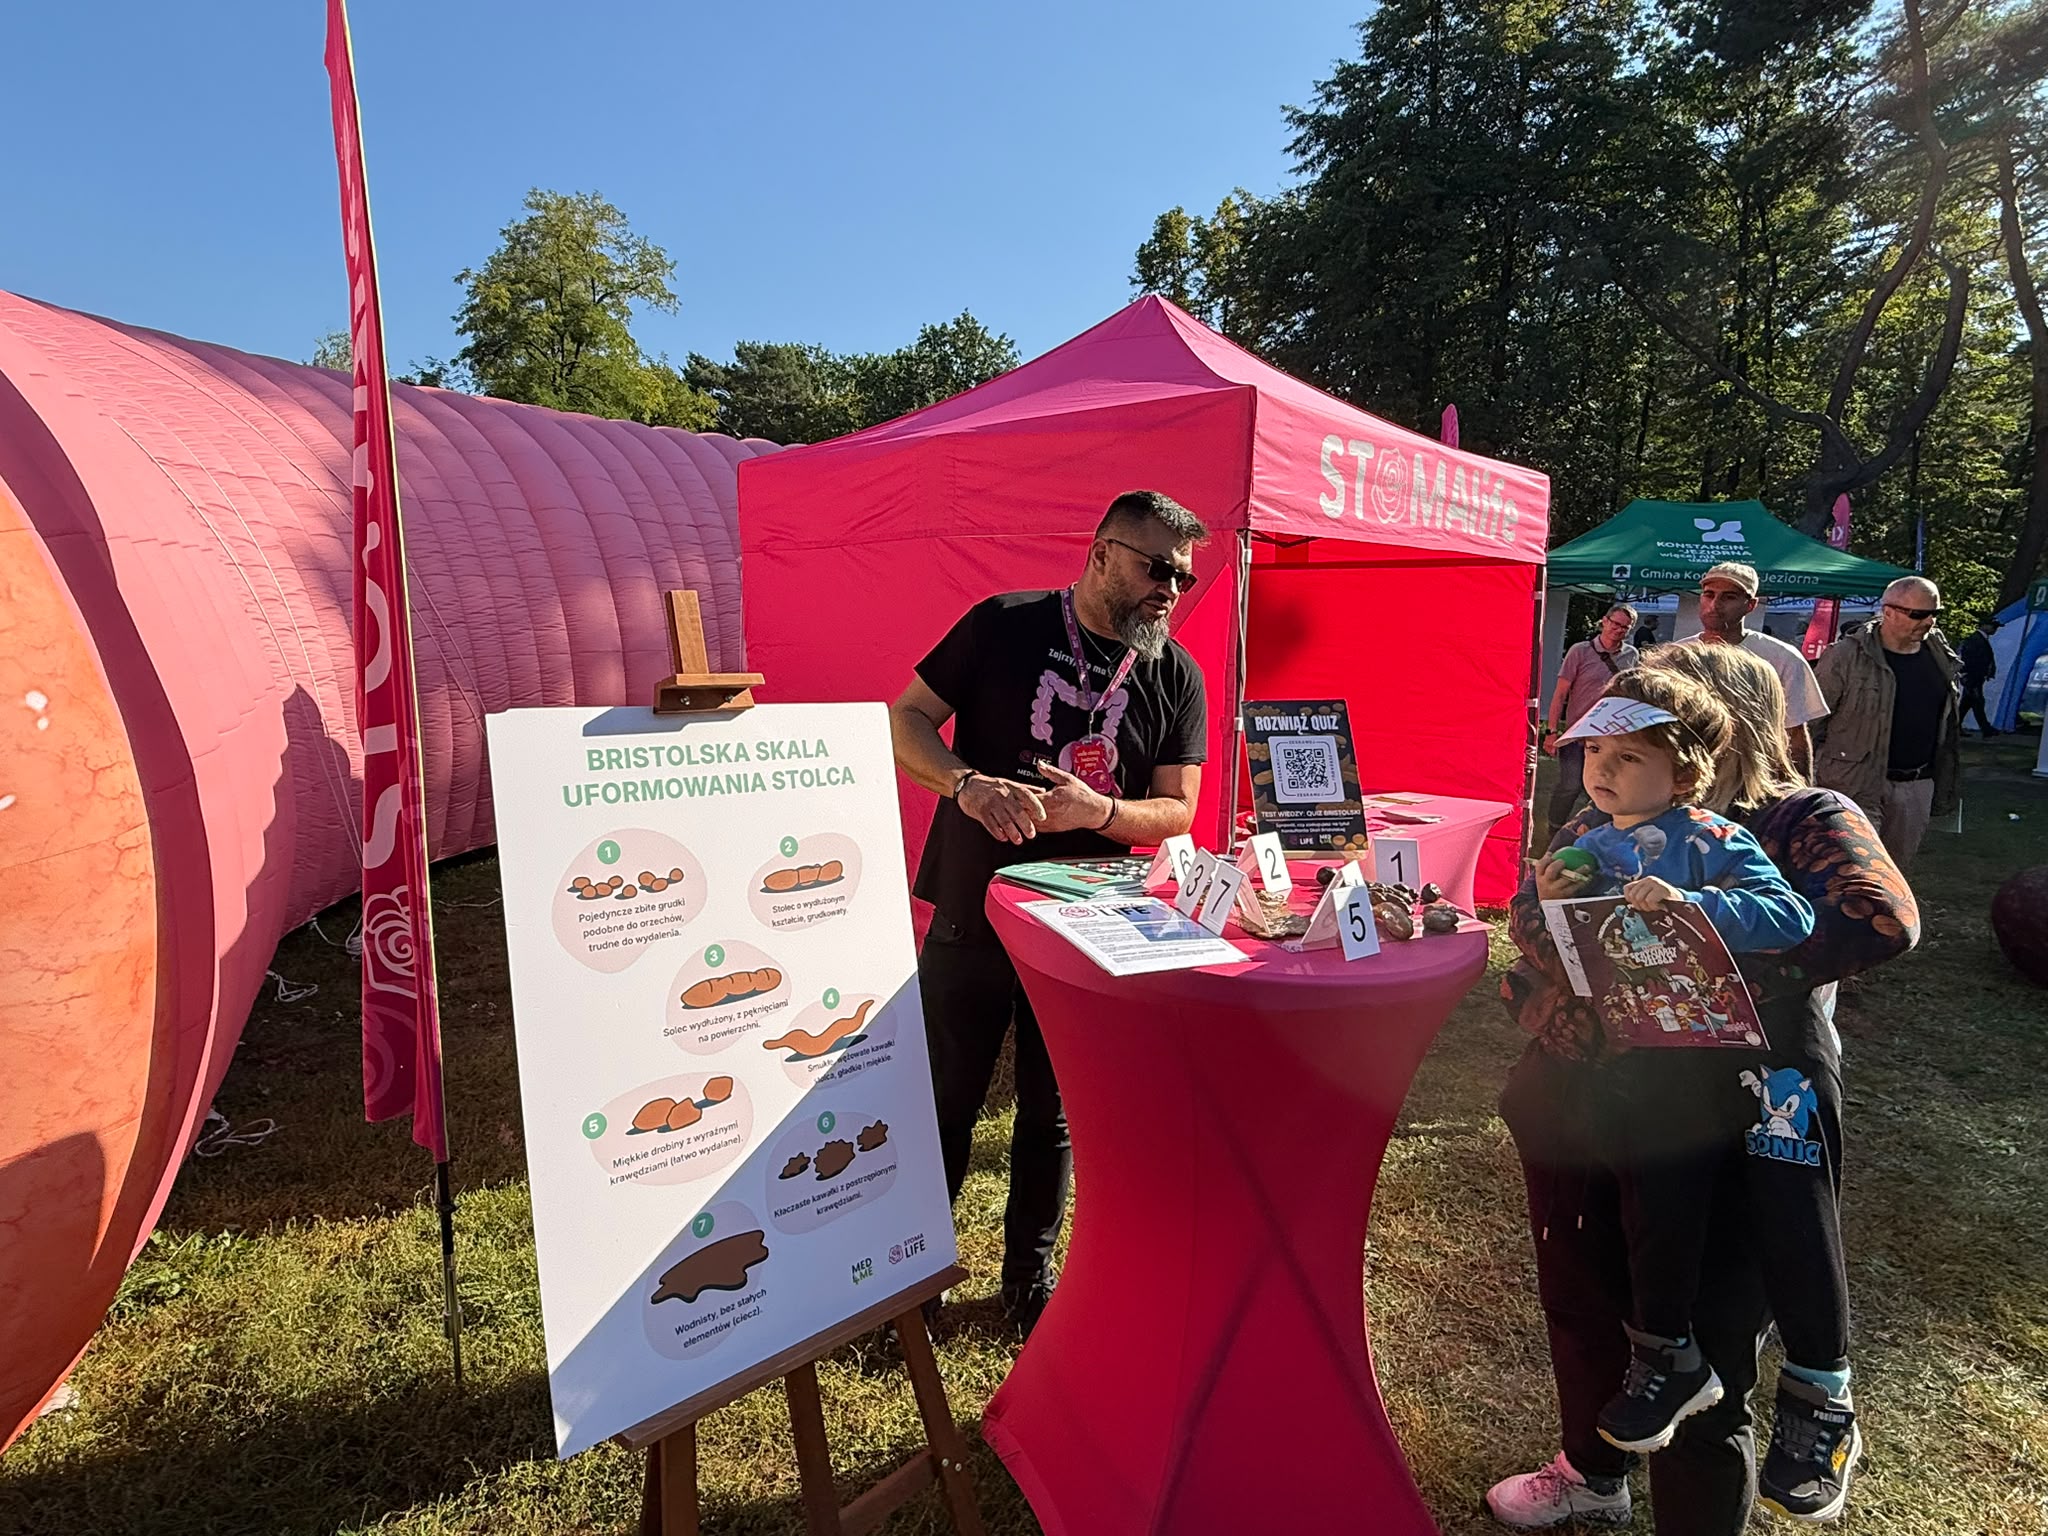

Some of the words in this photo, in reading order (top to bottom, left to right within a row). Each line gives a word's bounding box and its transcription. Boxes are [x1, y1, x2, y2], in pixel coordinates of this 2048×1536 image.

[1656, 541, 1750, 550] KONSTANCIN-
[1640, 568, 1680, 579] Gmina
[1254, 712, 1309, 735] ROZWIĄŻ
[1310, 715, 1339, 731] QUIZ
[586, 742, 751, 771] BRISTOLSKA
[755, 739, 830, 761] SKALA
[562, 772, 767, 808] UFORMOWANIA
[771, 766, 856, 791] STOLCA
[604, 846, 612, 858] 1
[784, 841, 792, 852] 2
[1264, 847, 1282, 880] 2
[1390, 851, 1403, 882] 1
[1186, 864, 1204, 897] 3
[1211, 879, 1231, 914] 7
[579, 907, 633, 923] Pojedyncze
[634, 903, 657, 914] zbite
[658, 898, 686, 912] grudki
[772, 903, 796, 914] Stolec
[1098, 906, 1151, 916] LIFE
[583, 923, 624, 939] podobne
[626, 921, 638, 930] do
[639, 914, 685, 928] orzechów,
[1349, 902, 1366, 943] 5
[588, 939, 620, 952] trudne
[621, 937, 634, 946] do
[635, 928, 681, 944] wydalenia.
[709, 949, 719, 962] 3
[827, 993, 834, 1004] 4
[663, 1025, 688, 1037] Solec
[689, 1013, 736, 1031] wydłużony,
[743, 999, 789, 1019] pęknięciami
[698, 1034, 709, 1043] na
[710, 1020, 761, 1042] powierzchni.
[588, 1119, 599, 1133] 5
[822, 1117, 830, 1128] 6
[612, 1150, 649, 1169] Miękkie
[651, 1139, 685, 1157] drobiny
[686, 1137, 692, 1145] z
[693, 1120, 739, 1142] wyraźnymi
[1745, 1130, 1821, 1165] SONIC
[609, 1159, 668, 1186] krawędziami
[670, 1150, 698, 1167] (łatwo
[699, 1134, 744, 1156] wydalane).
[840, 1184, 845, 1192] z
[698, 1218, 706, 1232] 7
[904, 1239, 926, 1259] LIFE
[851, 1257, 873, 1274] MED
[674, 1311, 719, 1336] Wodnisty,
[720, 1303, 736, 1316] bez
[737, 1288, 767, 1308] stałych
[683, 1319, 731, 1348] elementów
[732, 1306, 763, 1327] (ciecz).
